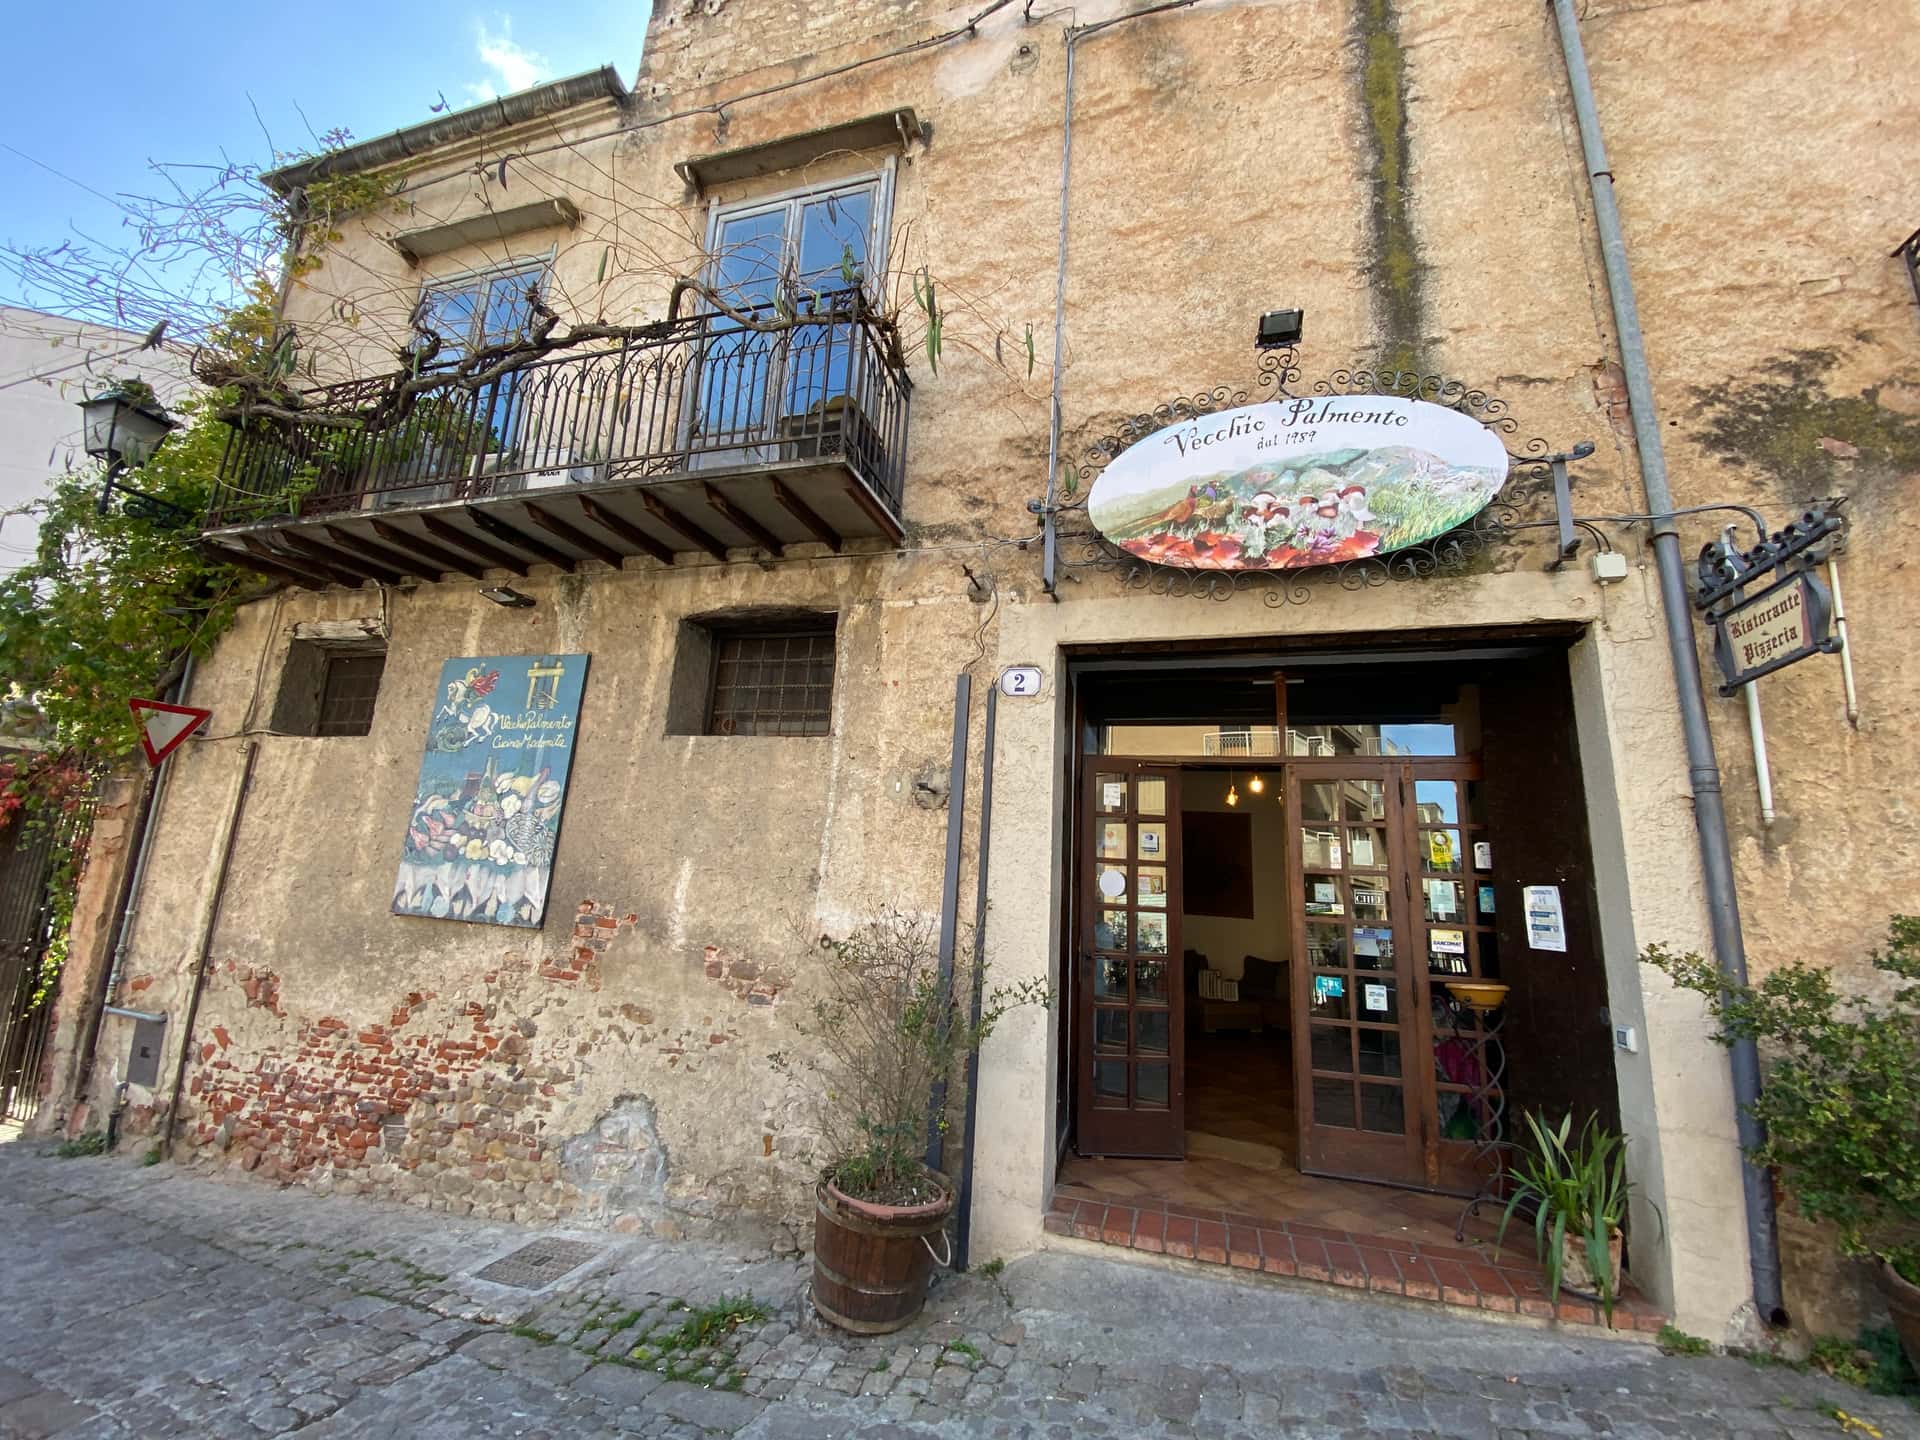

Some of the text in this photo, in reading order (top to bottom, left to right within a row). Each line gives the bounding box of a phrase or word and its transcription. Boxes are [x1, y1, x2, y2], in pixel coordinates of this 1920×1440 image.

[1163, 399, 1409, 457] Vecchio Palmento
[1257, 430, 1317, 451] dal 1989
[1731, 593, 1801, 639] Ristorante
[1743, 626, 1798, 665] Pizzeria
[1014, 673, 1025, 692] 2
